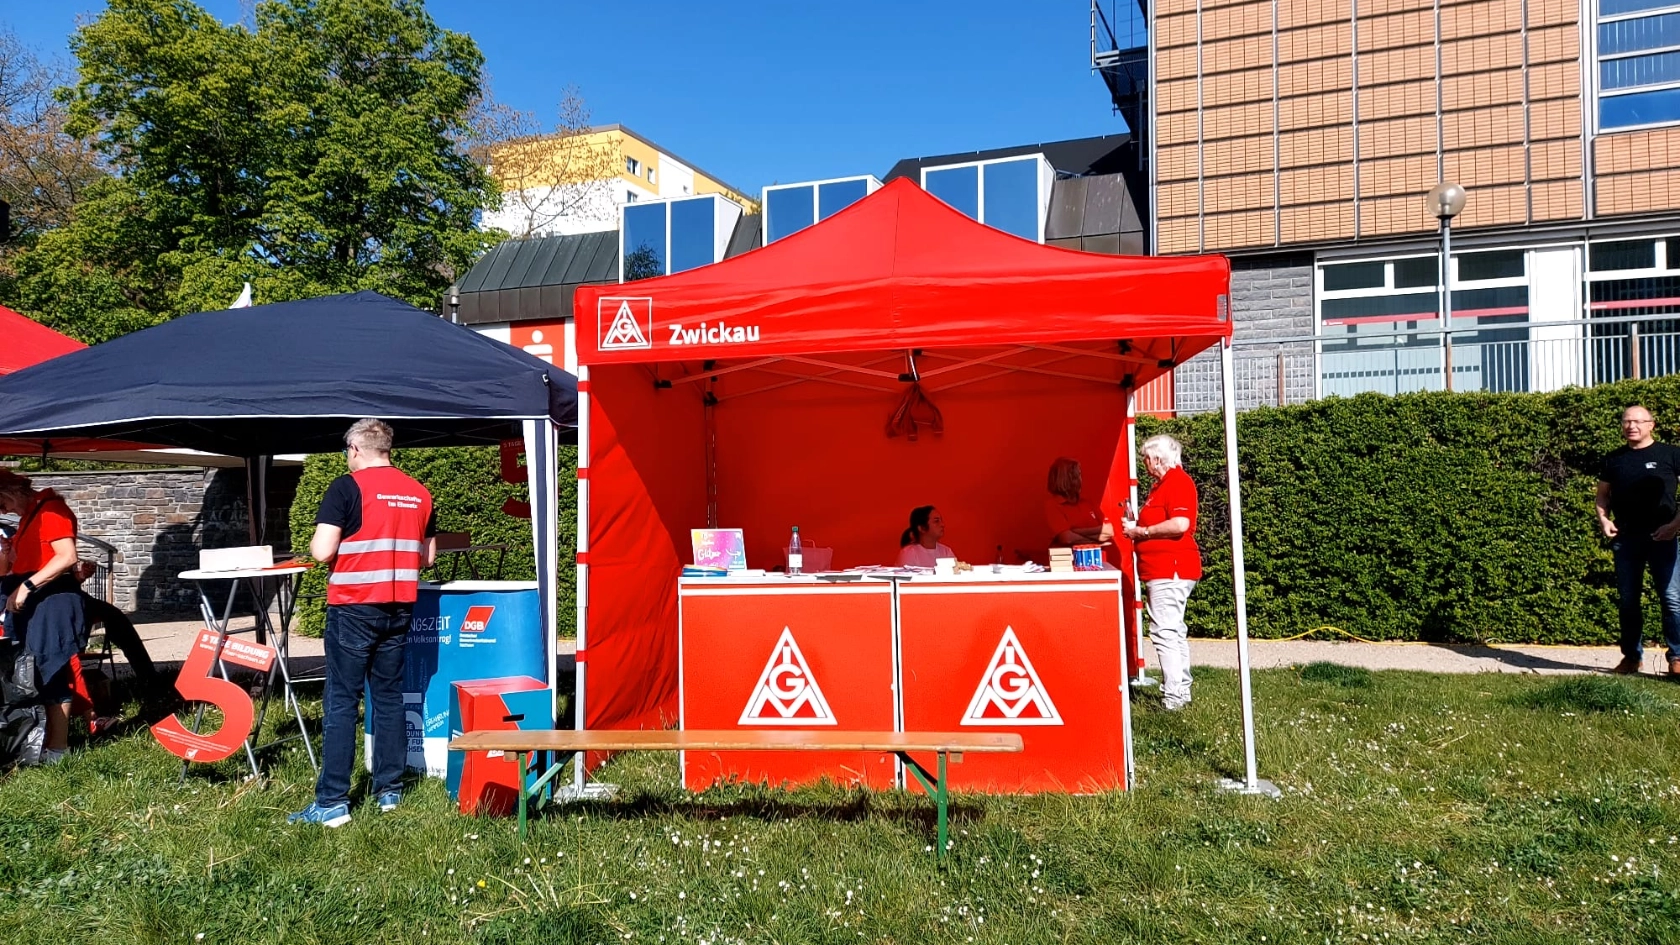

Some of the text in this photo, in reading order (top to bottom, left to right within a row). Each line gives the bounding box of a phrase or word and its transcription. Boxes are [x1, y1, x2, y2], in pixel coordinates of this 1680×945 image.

[668, 321, 760, 345] Zwickau
[464, 620, 485, 631] DGB
[413, 634, 452, 645] Volksantrag!
[231, 642, 270, 660] BILDUNG
